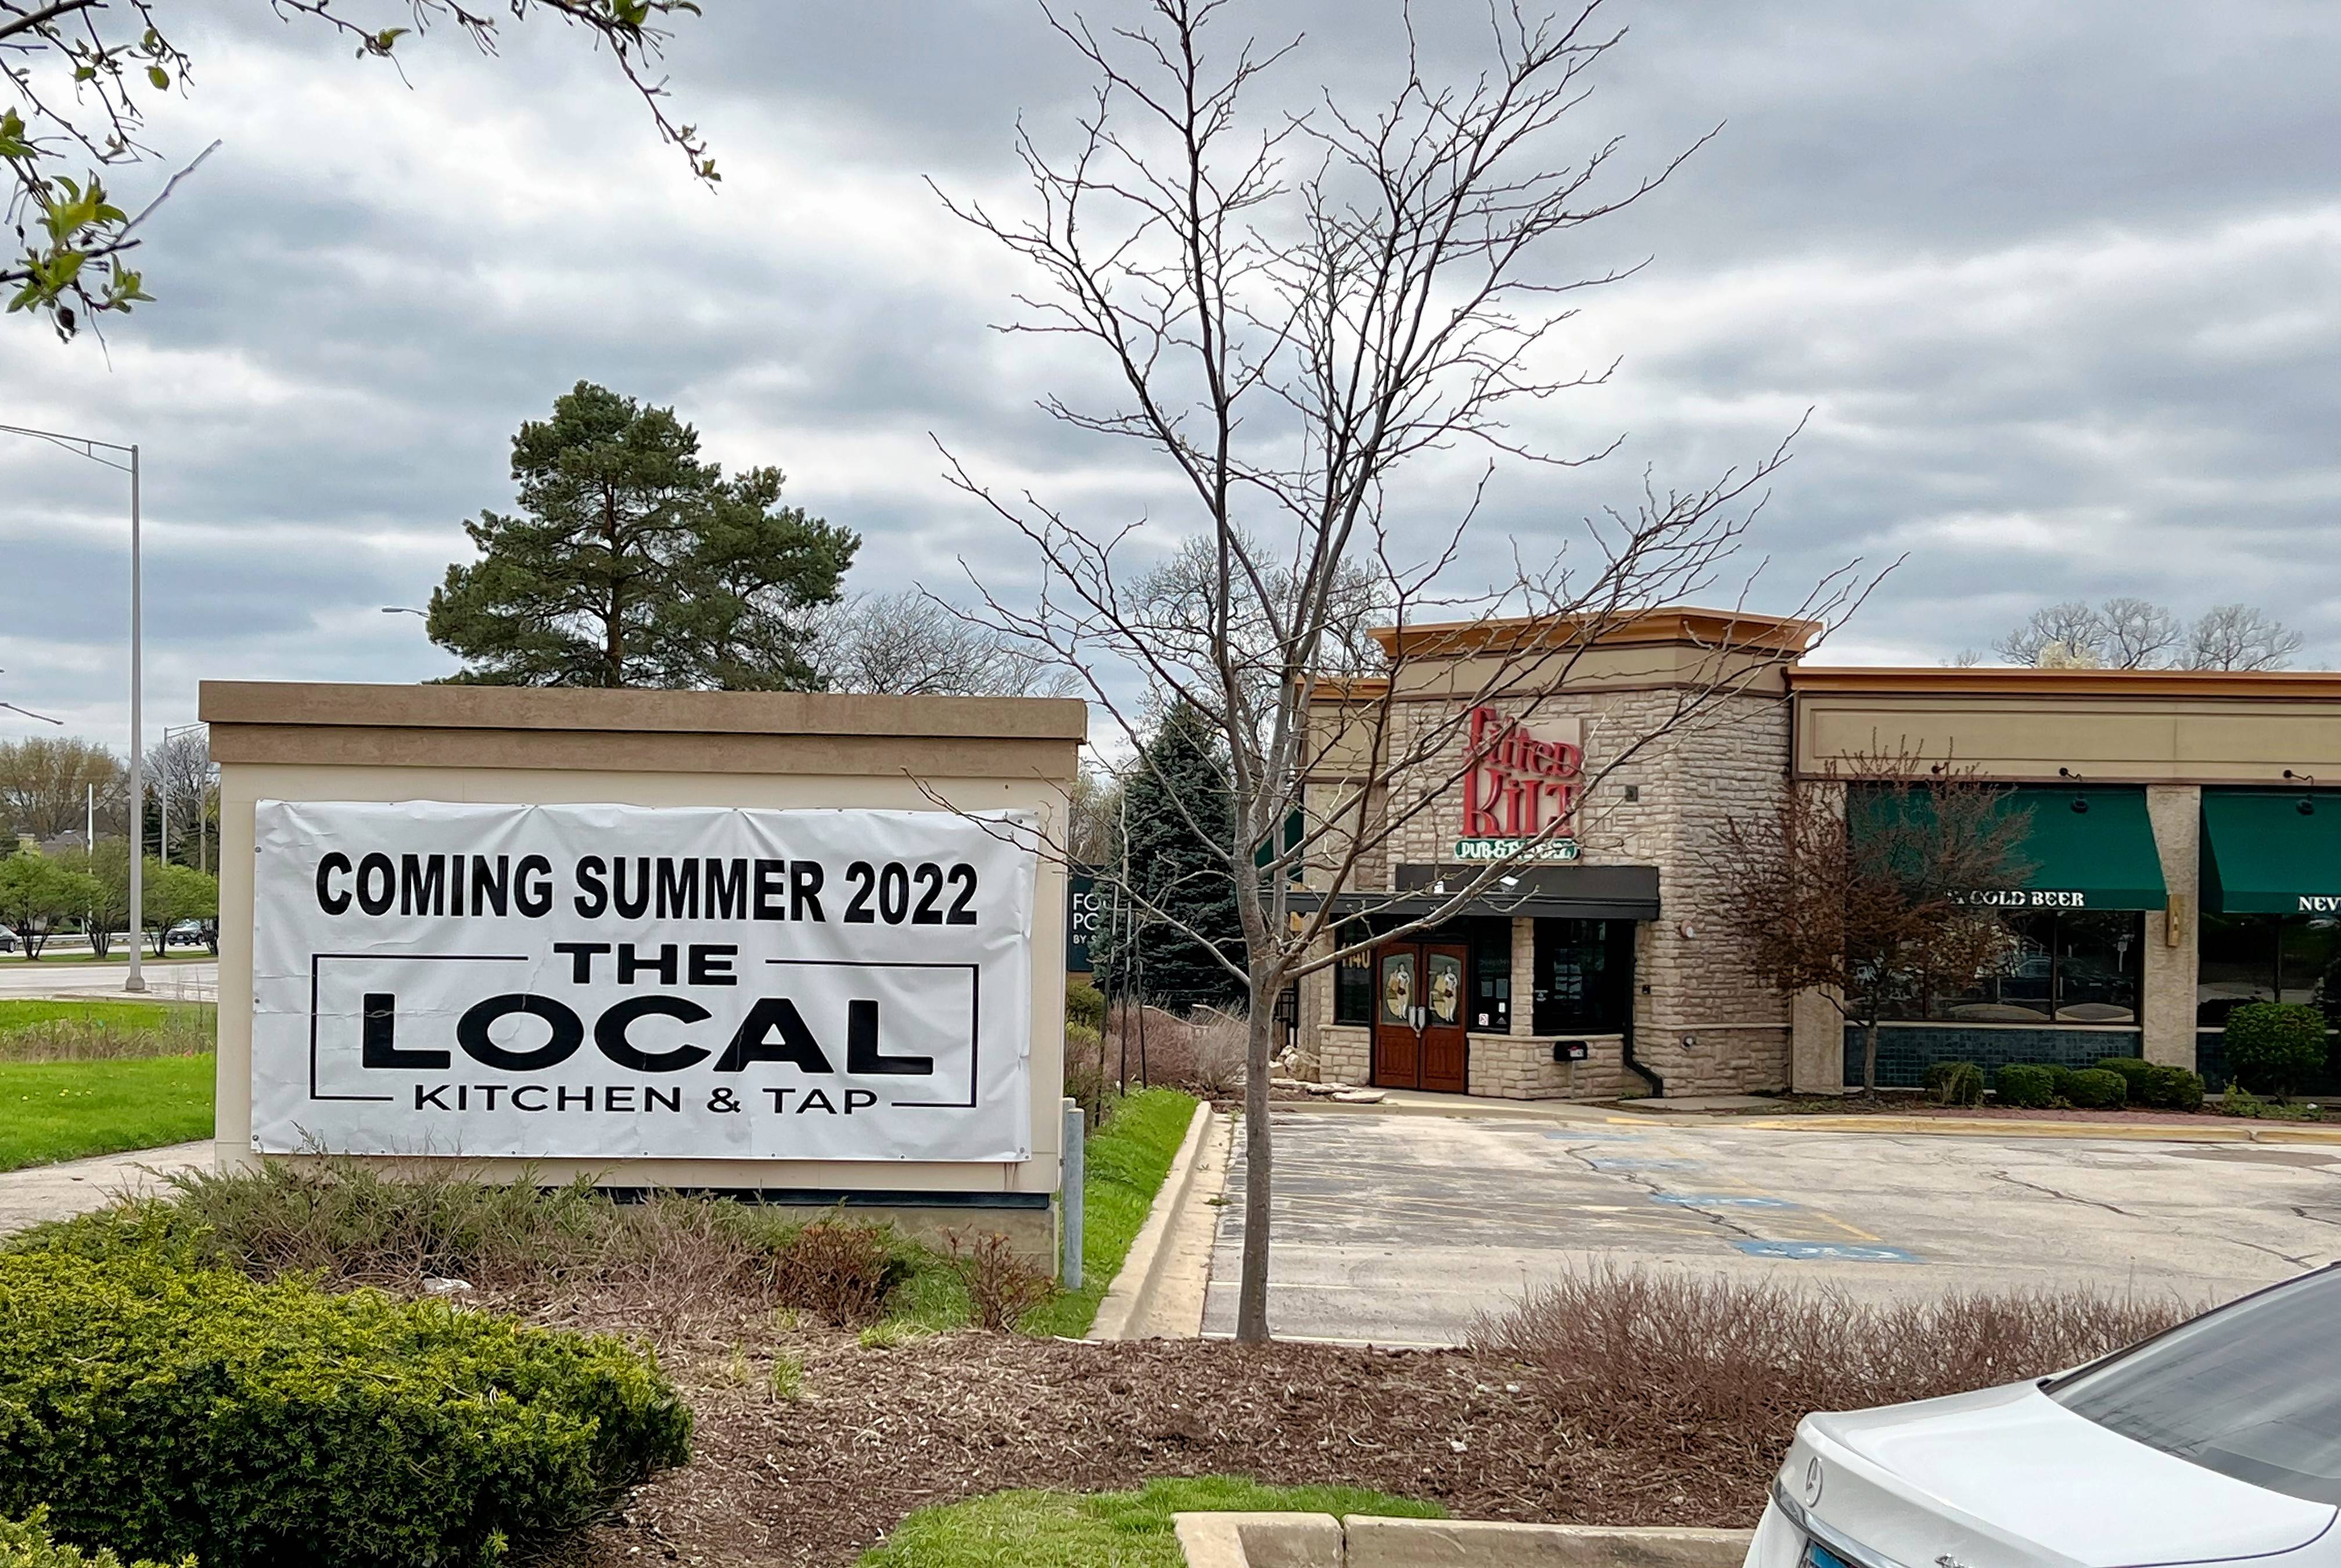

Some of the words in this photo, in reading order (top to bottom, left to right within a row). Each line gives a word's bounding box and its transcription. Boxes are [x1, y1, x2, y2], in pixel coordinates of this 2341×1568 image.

[1461, 842, 1491, 859] PUB
[315, 851, 553, 919] COMING
[573, 855, 827, 923] SUMMER
[843, 861, 978, 926] 2022
[1969, 890, 2026, 906] COLD
[2031, 891, 2085, 907] BEER
[2298, 896, 2341, 912] NEV
[1073, 934, 1087, 944] BY
[553, 942, 739, 986] THE
[362, 992, 934, 1076] LOCAL
[414, 1084, 681, 1113] KITCHEN
[706, 1087, 742, 1114] &
[762, 1088, 878, 1115] TAP
